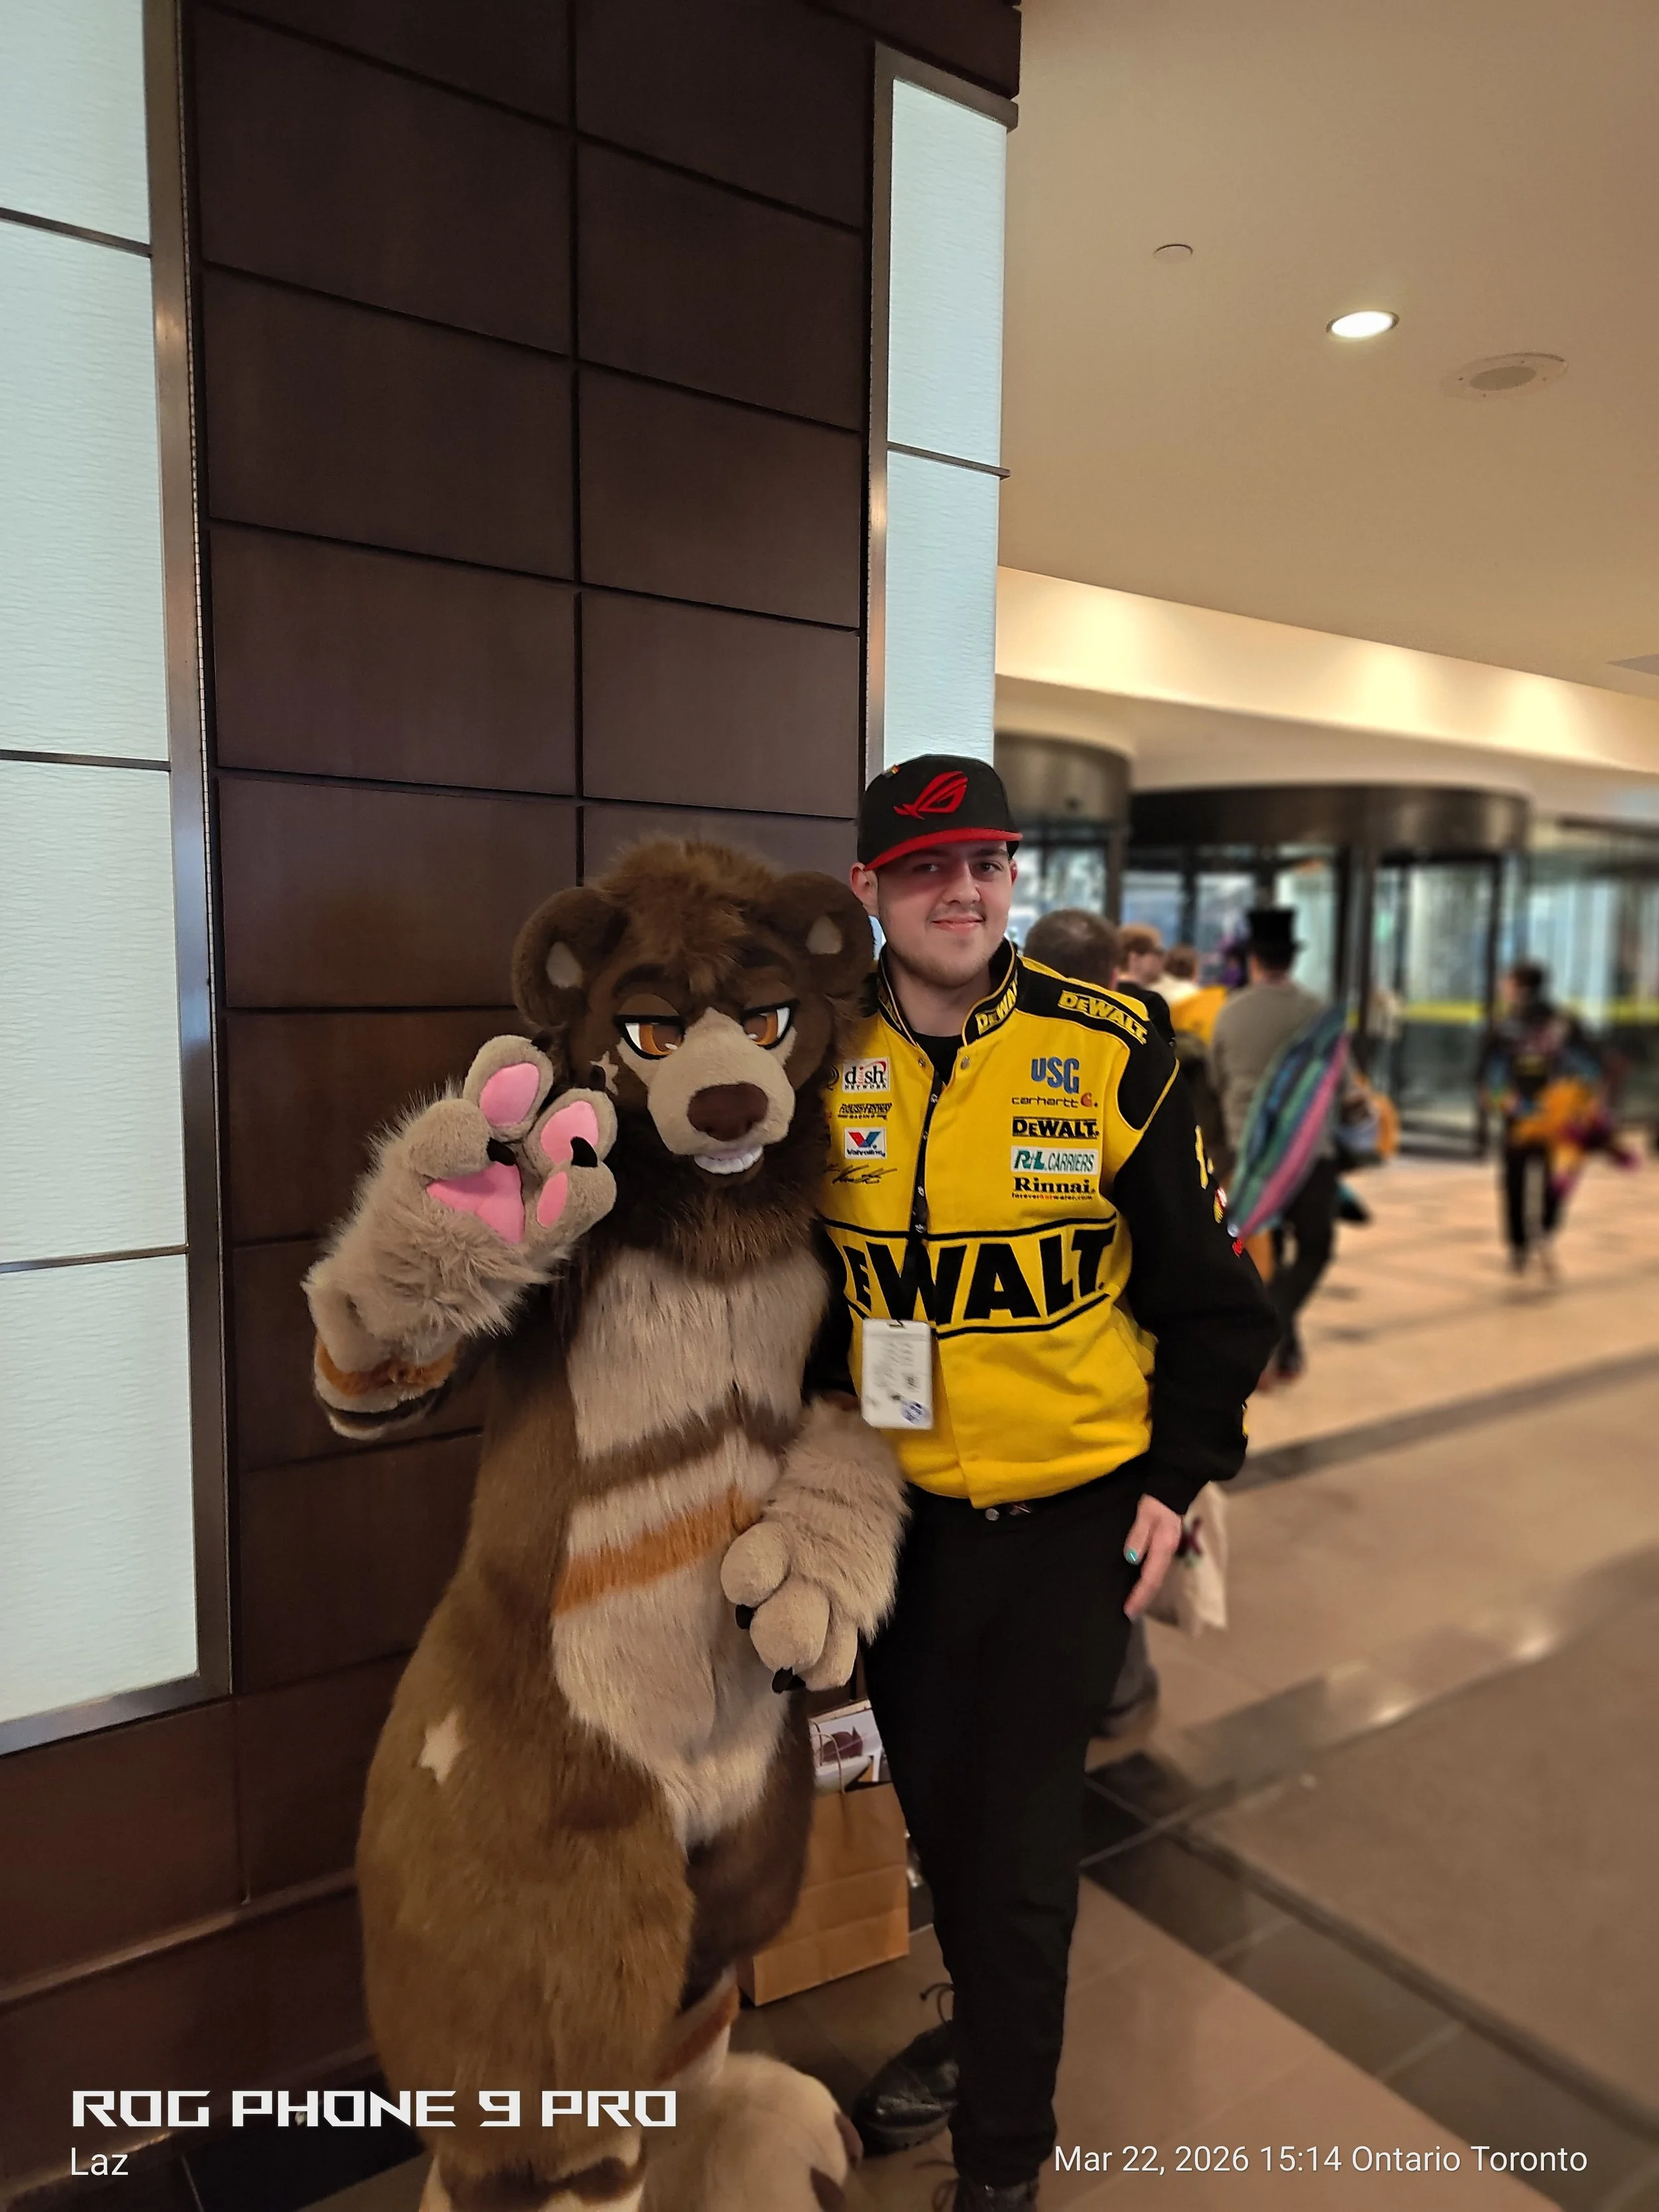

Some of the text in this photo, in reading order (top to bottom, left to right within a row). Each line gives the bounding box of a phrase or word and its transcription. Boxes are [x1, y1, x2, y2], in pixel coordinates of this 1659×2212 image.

[844, 1065, 885, 1084] dish
[1031, 1057, 1080, 1094] USG
[1011, 1096, 1078, 1108] carhartt
[1048, 1152, 1095, 1173] CARRIERS
[1013, 1177, 1091, 1194] Rinnai
[842, 1224, 1116, 1325] EWALT
